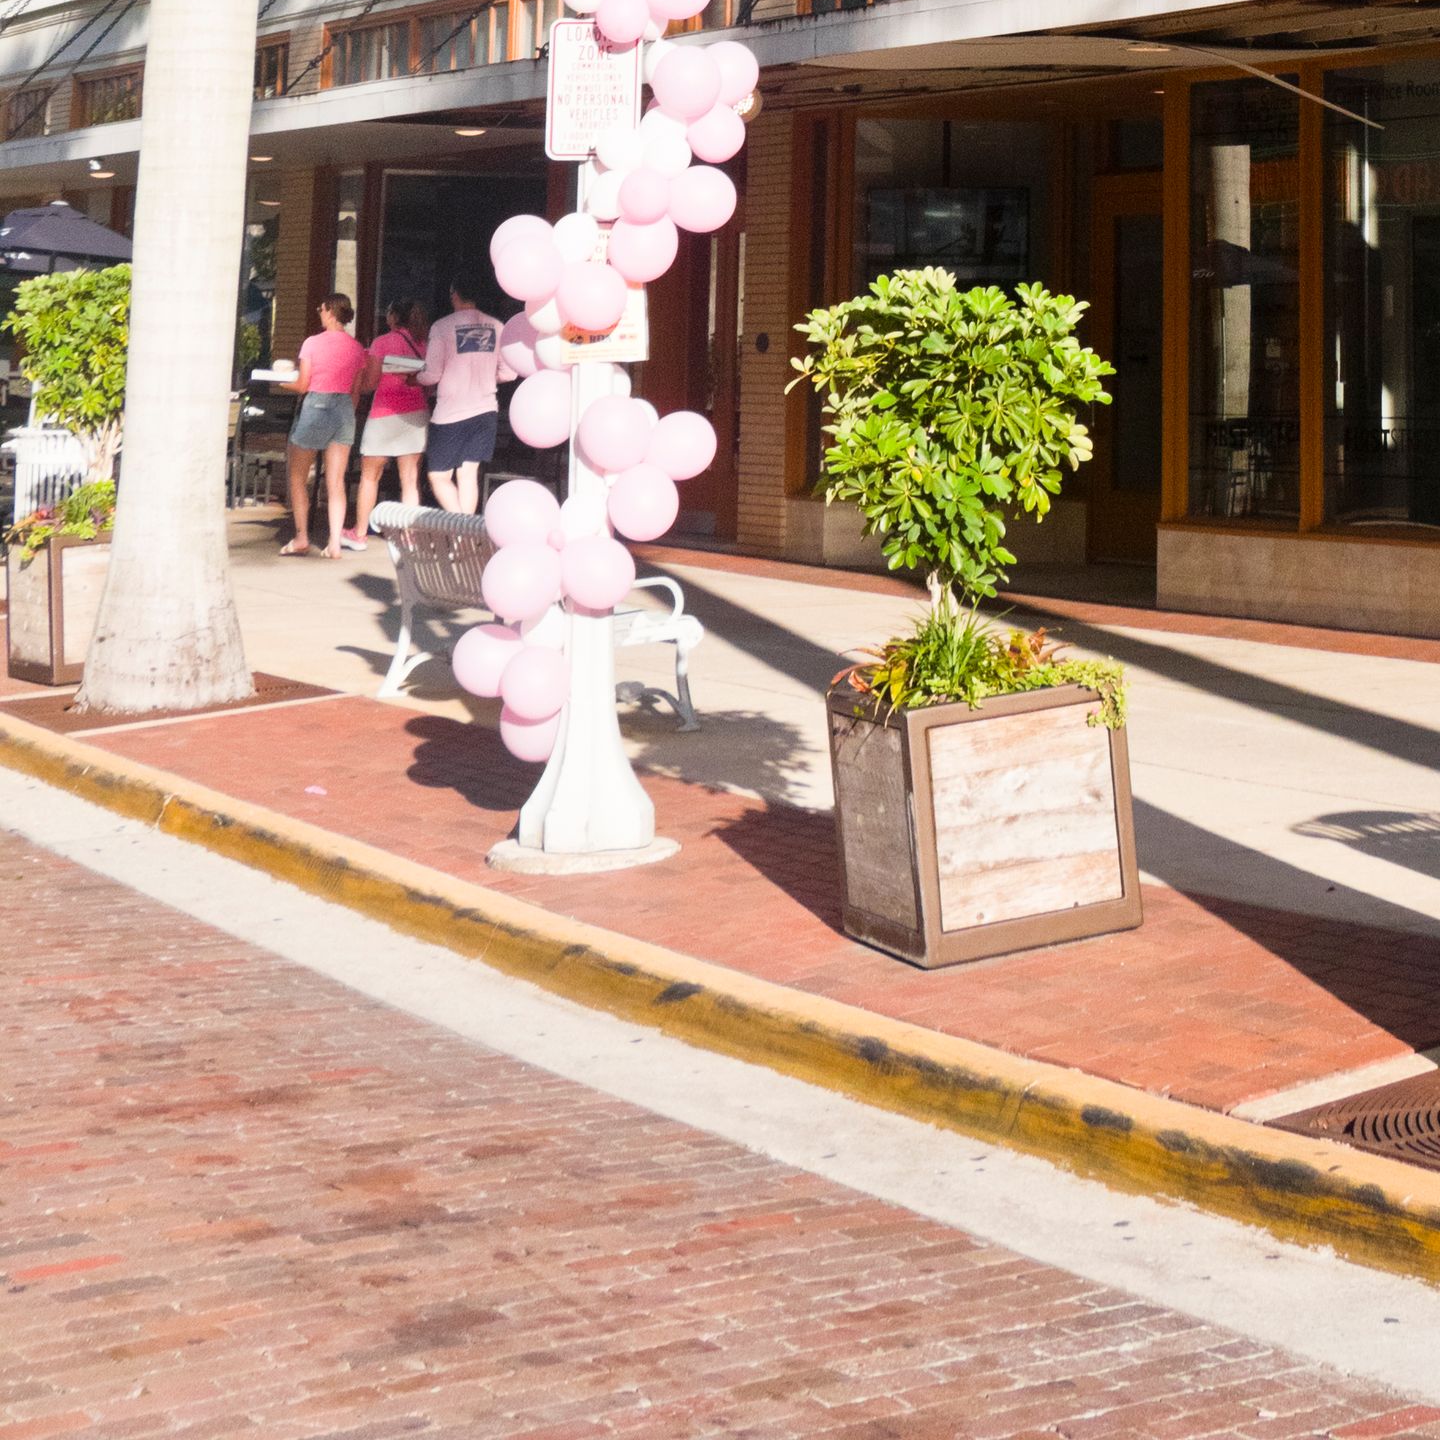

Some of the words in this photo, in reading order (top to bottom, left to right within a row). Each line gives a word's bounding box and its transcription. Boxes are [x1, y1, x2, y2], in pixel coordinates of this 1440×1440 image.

[557, 94, 571, 105] NO
[576, 94, 631, 105] PERSONAL
[569, 108, 618, 120] VEHICLES
